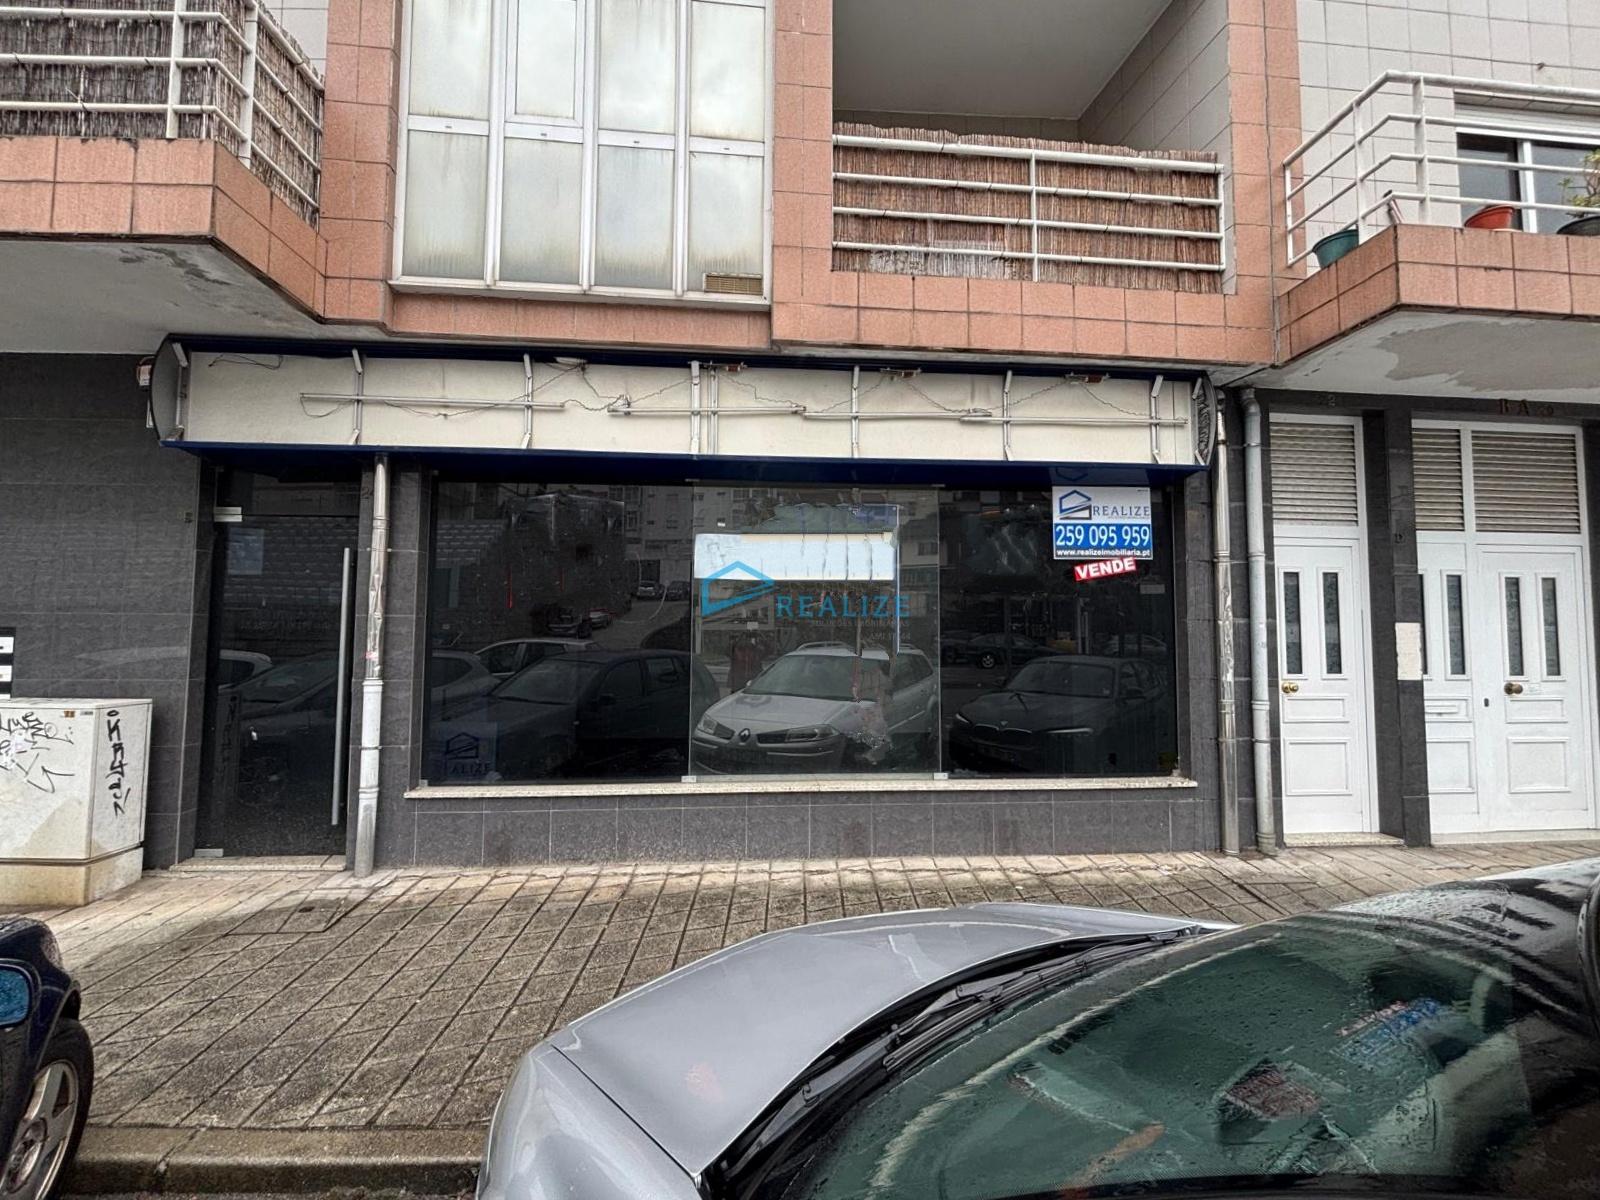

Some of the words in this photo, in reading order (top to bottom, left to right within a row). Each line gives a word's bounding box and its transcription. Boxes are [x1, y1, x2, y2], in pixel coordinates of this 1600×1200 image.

[1093, 505, 1150, 517] REALIZE
[1055, 525, 1085, 546] 259
[1088, 525, 1118, 547] 095
[1121, 526, 1150, 547] 959
[1056, 548, 1151, 557] www.realizeimobiliaria.pt
[1075, 558, 1136, 579] VENDE
